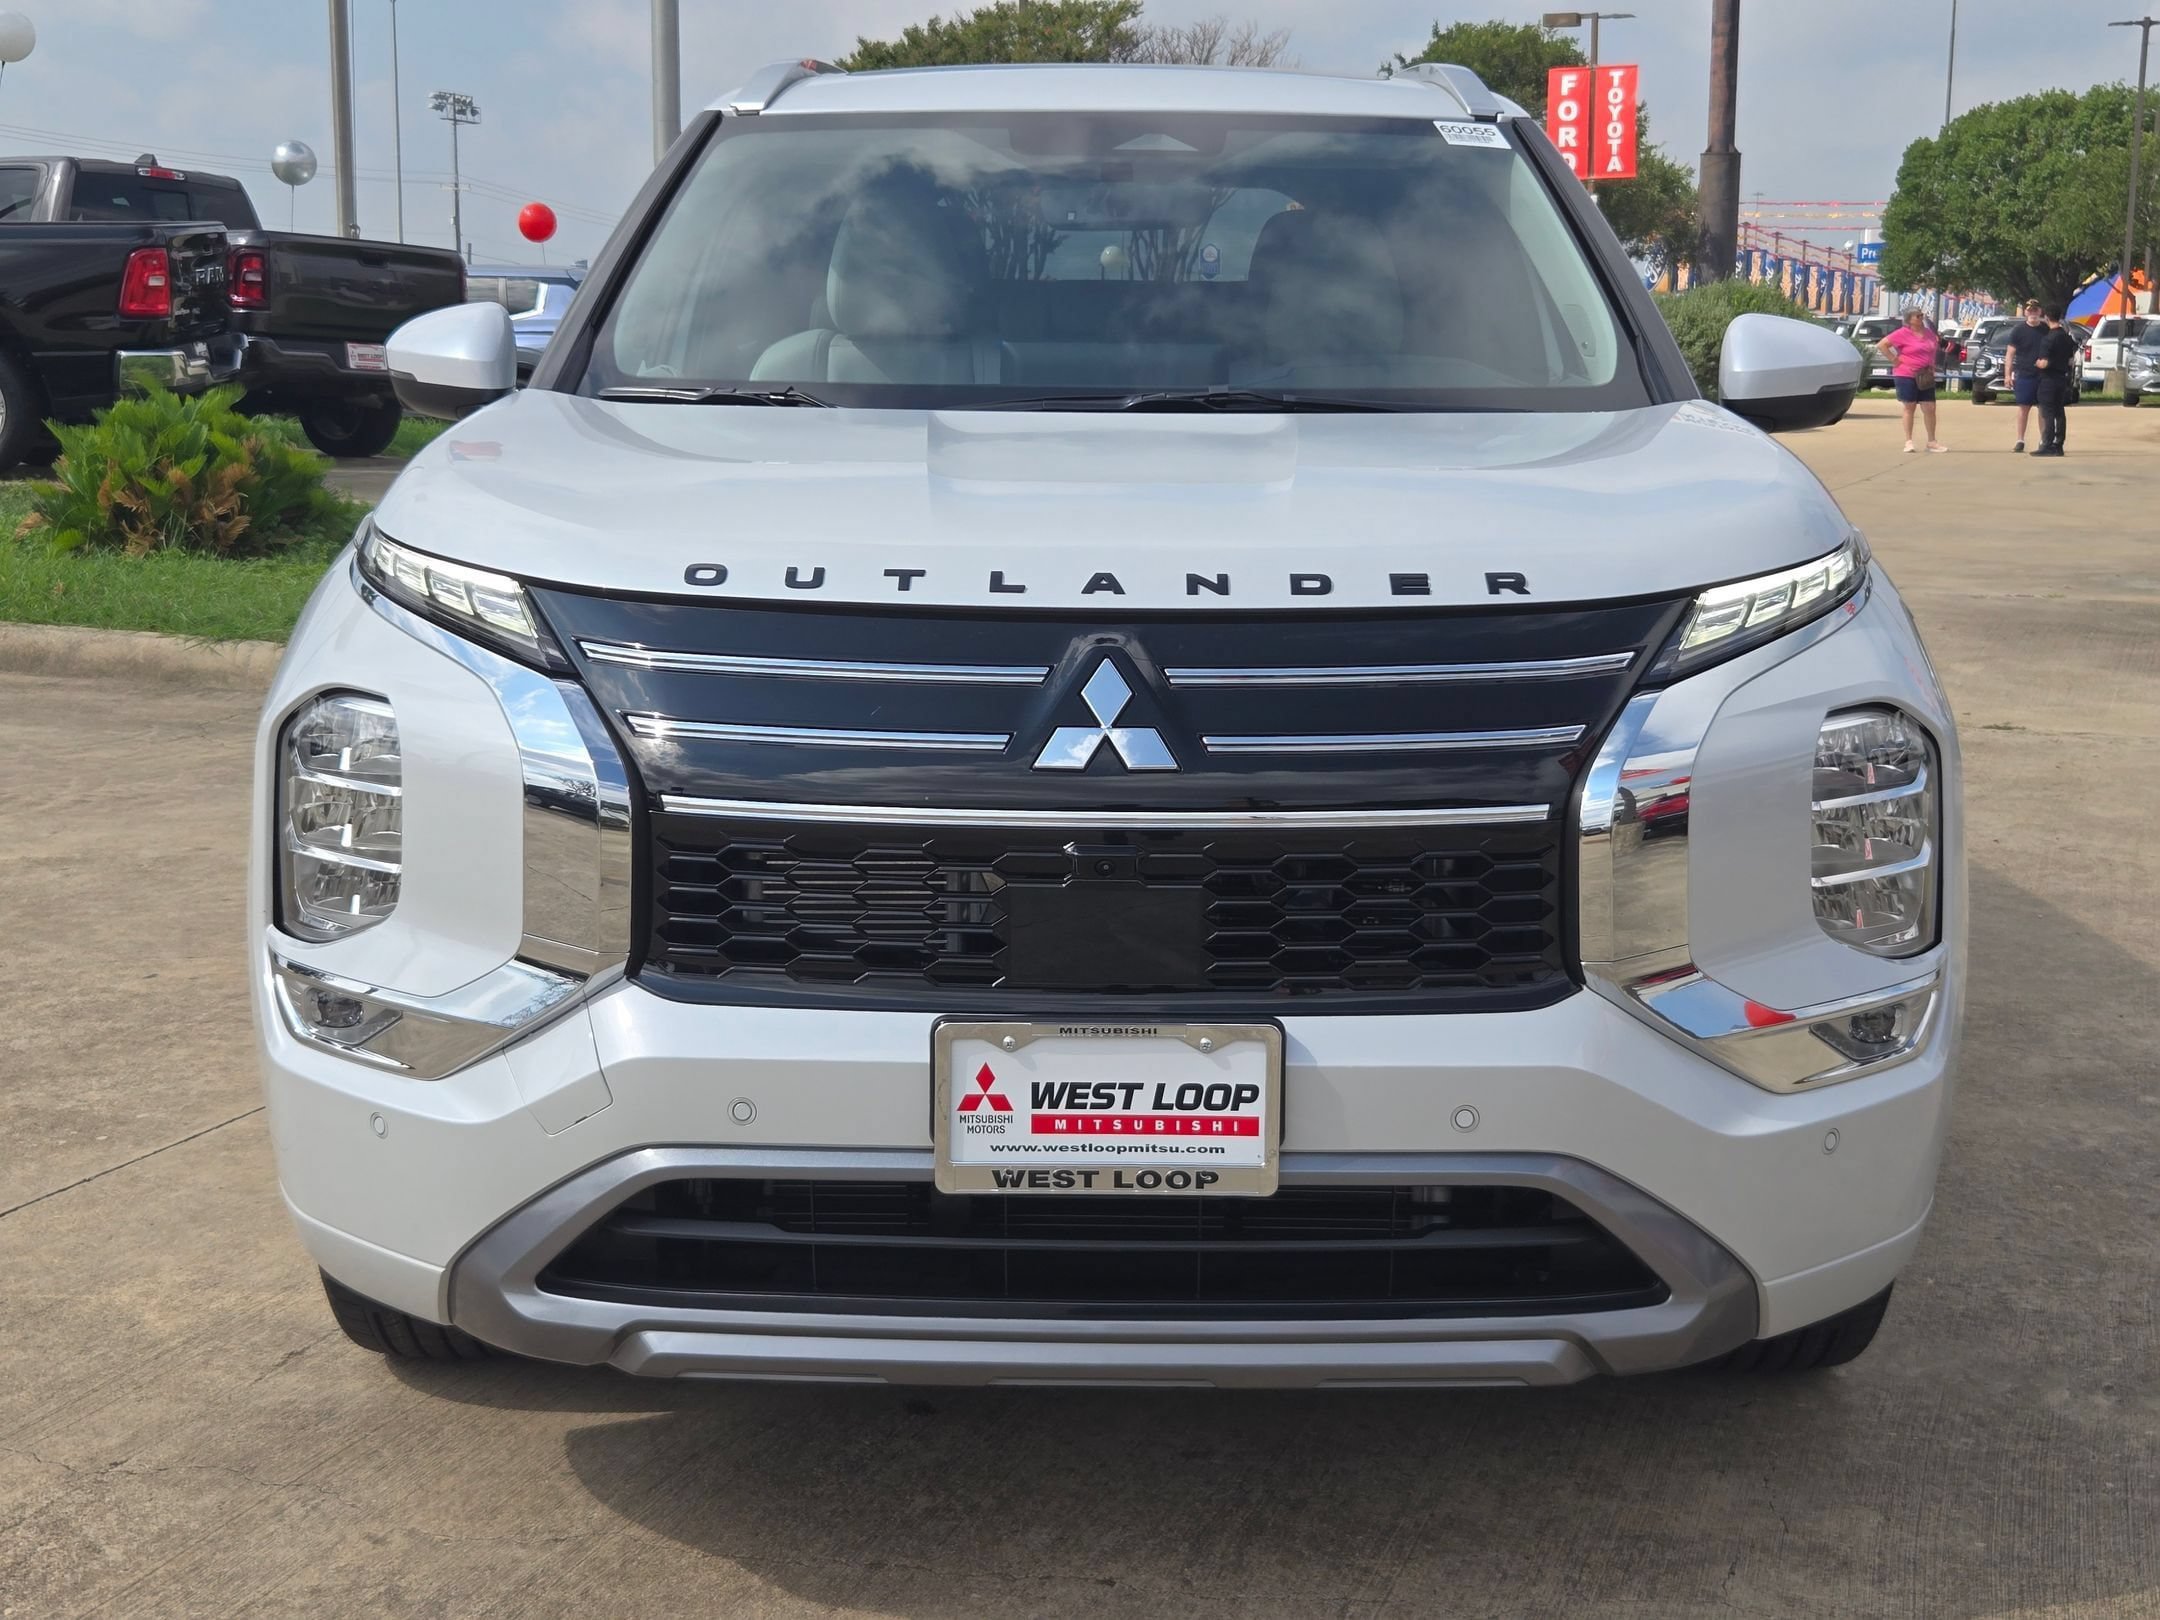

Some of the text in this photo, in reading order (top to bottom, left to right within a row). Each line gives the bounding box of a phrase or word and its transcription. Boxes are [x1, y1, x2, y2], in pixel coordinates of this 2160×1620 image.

[1557, 73, 1579, 171] FORD
[1606, 70, 1624, 173] TOYOTA
[1439, 125, 1496, 137] 60055
[684, 562, 1532, 596] OUTLANDER
[1059, 1027, 1158, 1035] MITSUBISHI
[1031, 1081, 1260, 1112] WEST LOOP
[959, 1114, 1013, 1124] MITSUBISHI
[1054, 1119, 1238, 1132] MITSUBISHI
[966, 1125, 1006, 1134] MOTORS
[990, 1143, 1226, 1155] www.westloopmitsu.com
[992, 1169, 1220, 1190] WEST LOOP
